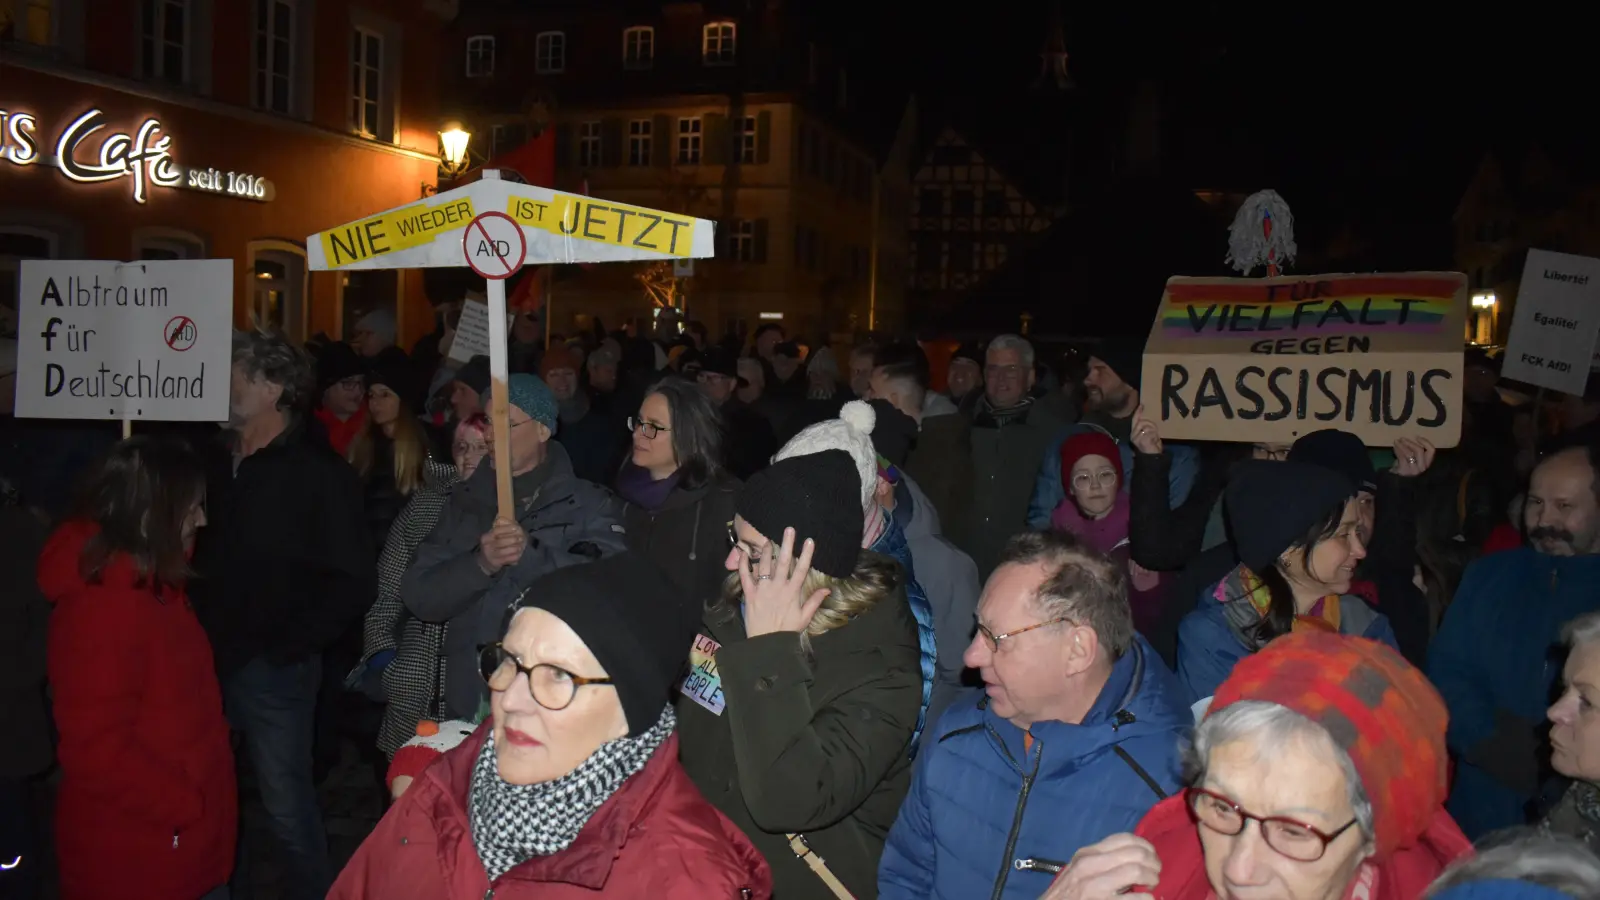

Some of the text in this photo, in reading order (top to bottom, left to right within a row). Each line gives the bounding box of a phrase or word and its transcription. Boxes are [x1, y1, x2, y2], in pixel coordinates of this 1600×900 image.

[0, 109, 266, 203] S Café seit 1616
[329, 201, 473, 265] NIE WIEDER
[515, 200, 690, 254] IST JETZT
[476, 239, 510, 258] AfD
[40, 276, 169, 308] Albtraum
[1186, 297, 1428, 334] VIELFALT
[40, 317, 97, 353] für
[170, 324, 194, 342] AfD
[1250, 334, 1371, 355] GEGEN
[44, 359, 205, 400] Deutschland
[1521, 352, 1572, 374] FCK AfD!
[1161, 362, 1453, 428] RASSISMUS
[696, 636, 719, 657] LOV
[697, 659, 716, 679] ALL
